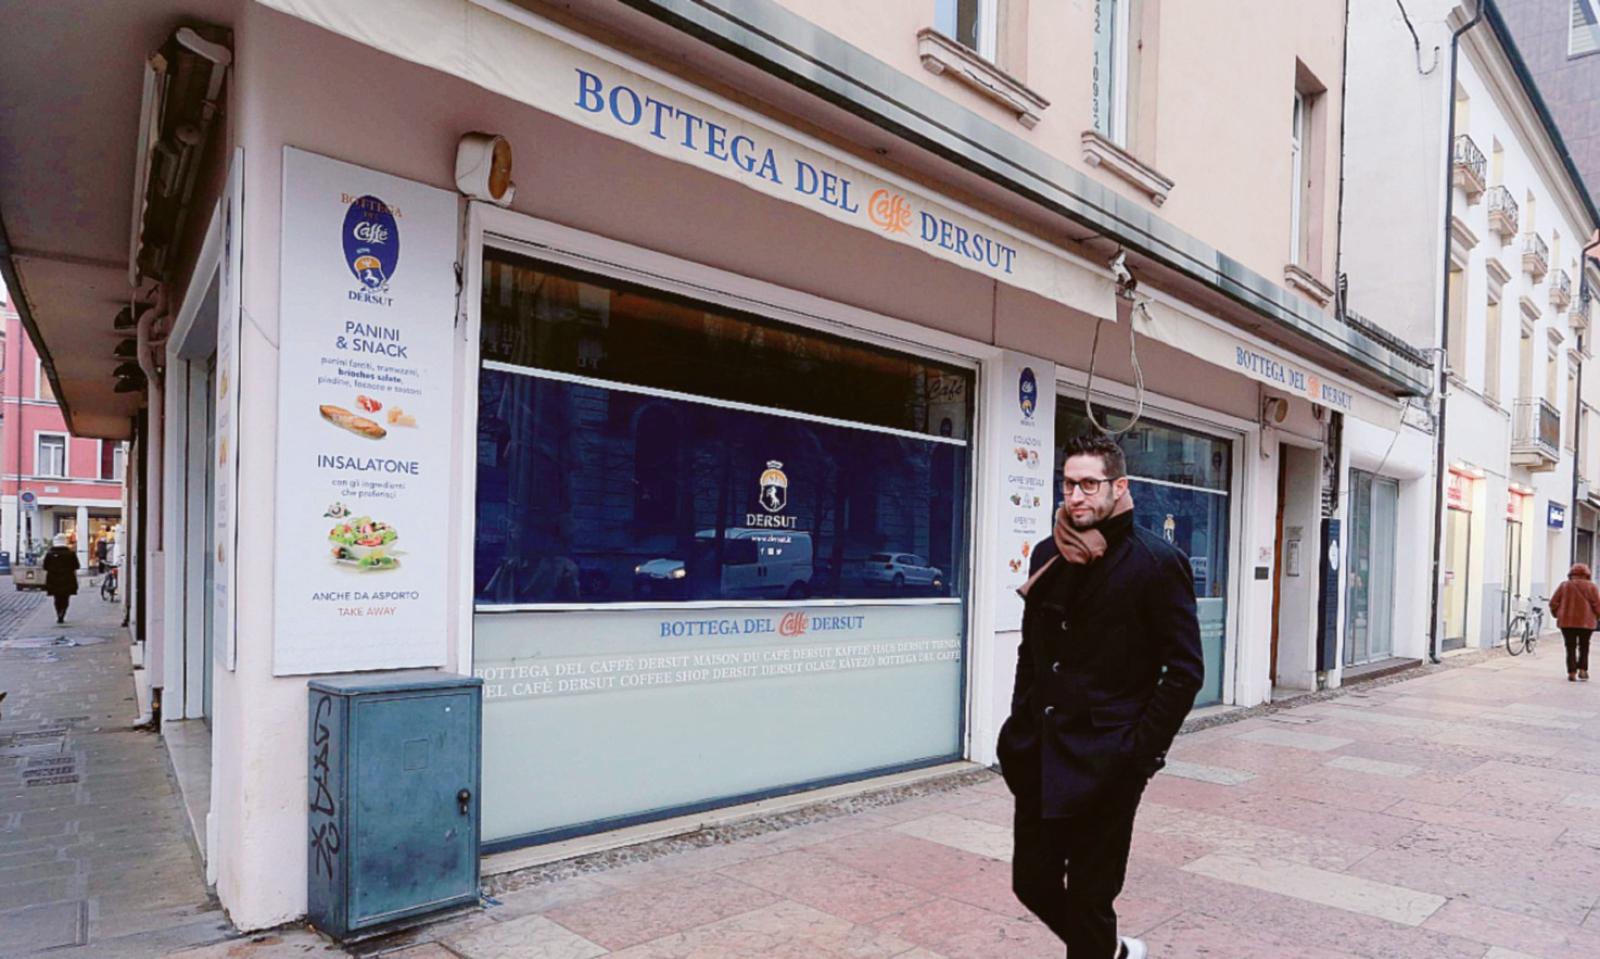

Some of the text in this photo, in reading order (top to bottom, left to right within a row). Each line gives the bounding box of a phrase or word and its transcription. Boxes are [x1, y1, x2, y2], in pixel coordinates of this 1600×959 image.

[574, 68, 783, 185] BOTTEGA
[795, 159, 859, 214] DEL
[920, 211, 1017, 274] DERSUT
[341, 192, 403, 218] BOTTEGA
[348, 290, 393, 307] DERSUT
[345, 321, 400, 342] PANINI
[336, 336, 408, 359] & SNACK
[321, 357, 348, 366] panini
[1236, 346, 1285, 383] BOTTEGA
[1288, 368, 1307, 392] DEL
[338, 367, 375, 380] brioches
[317, 454, 420, 475] INSALATONE
[331, 479, 406, 490] con gli ingredienti
[341, 488, 357, 497] che
[746, 513, 798, 528] DERSUT
[312, 591, 420, 602] ANCHE DA ASPORTO
[338, 607, 397, 617] TAKE AWAY
[660, 620, 740, 637] BOTTEGA
[744, 618, 775, 634] DEL
[812, 616, 865, 631] DERSUT
[474, 665, 550, 682] BOTTEGA
[555, 663, 586, 676] DEL
[638, 656, 690, 671] DERSUT
[693, 652, 740, 666] MAISON
[743, 651, 761, 663] DU
[792, 647, 833, 660] DERSUT
[897, 640, 930, 653] DERSUT
[558, 676, 617, 693] DERSUT
[620, 671, 673, 687] COFFEE
[675, 668, 710, 682] SHOP
[713, 665, 759, 681] DERSUT
[761, 662, 803, 676] DERSUT
[805, 659, 837, 673] OLASZ
[878, 654, 917, 667] BOTTEGA
